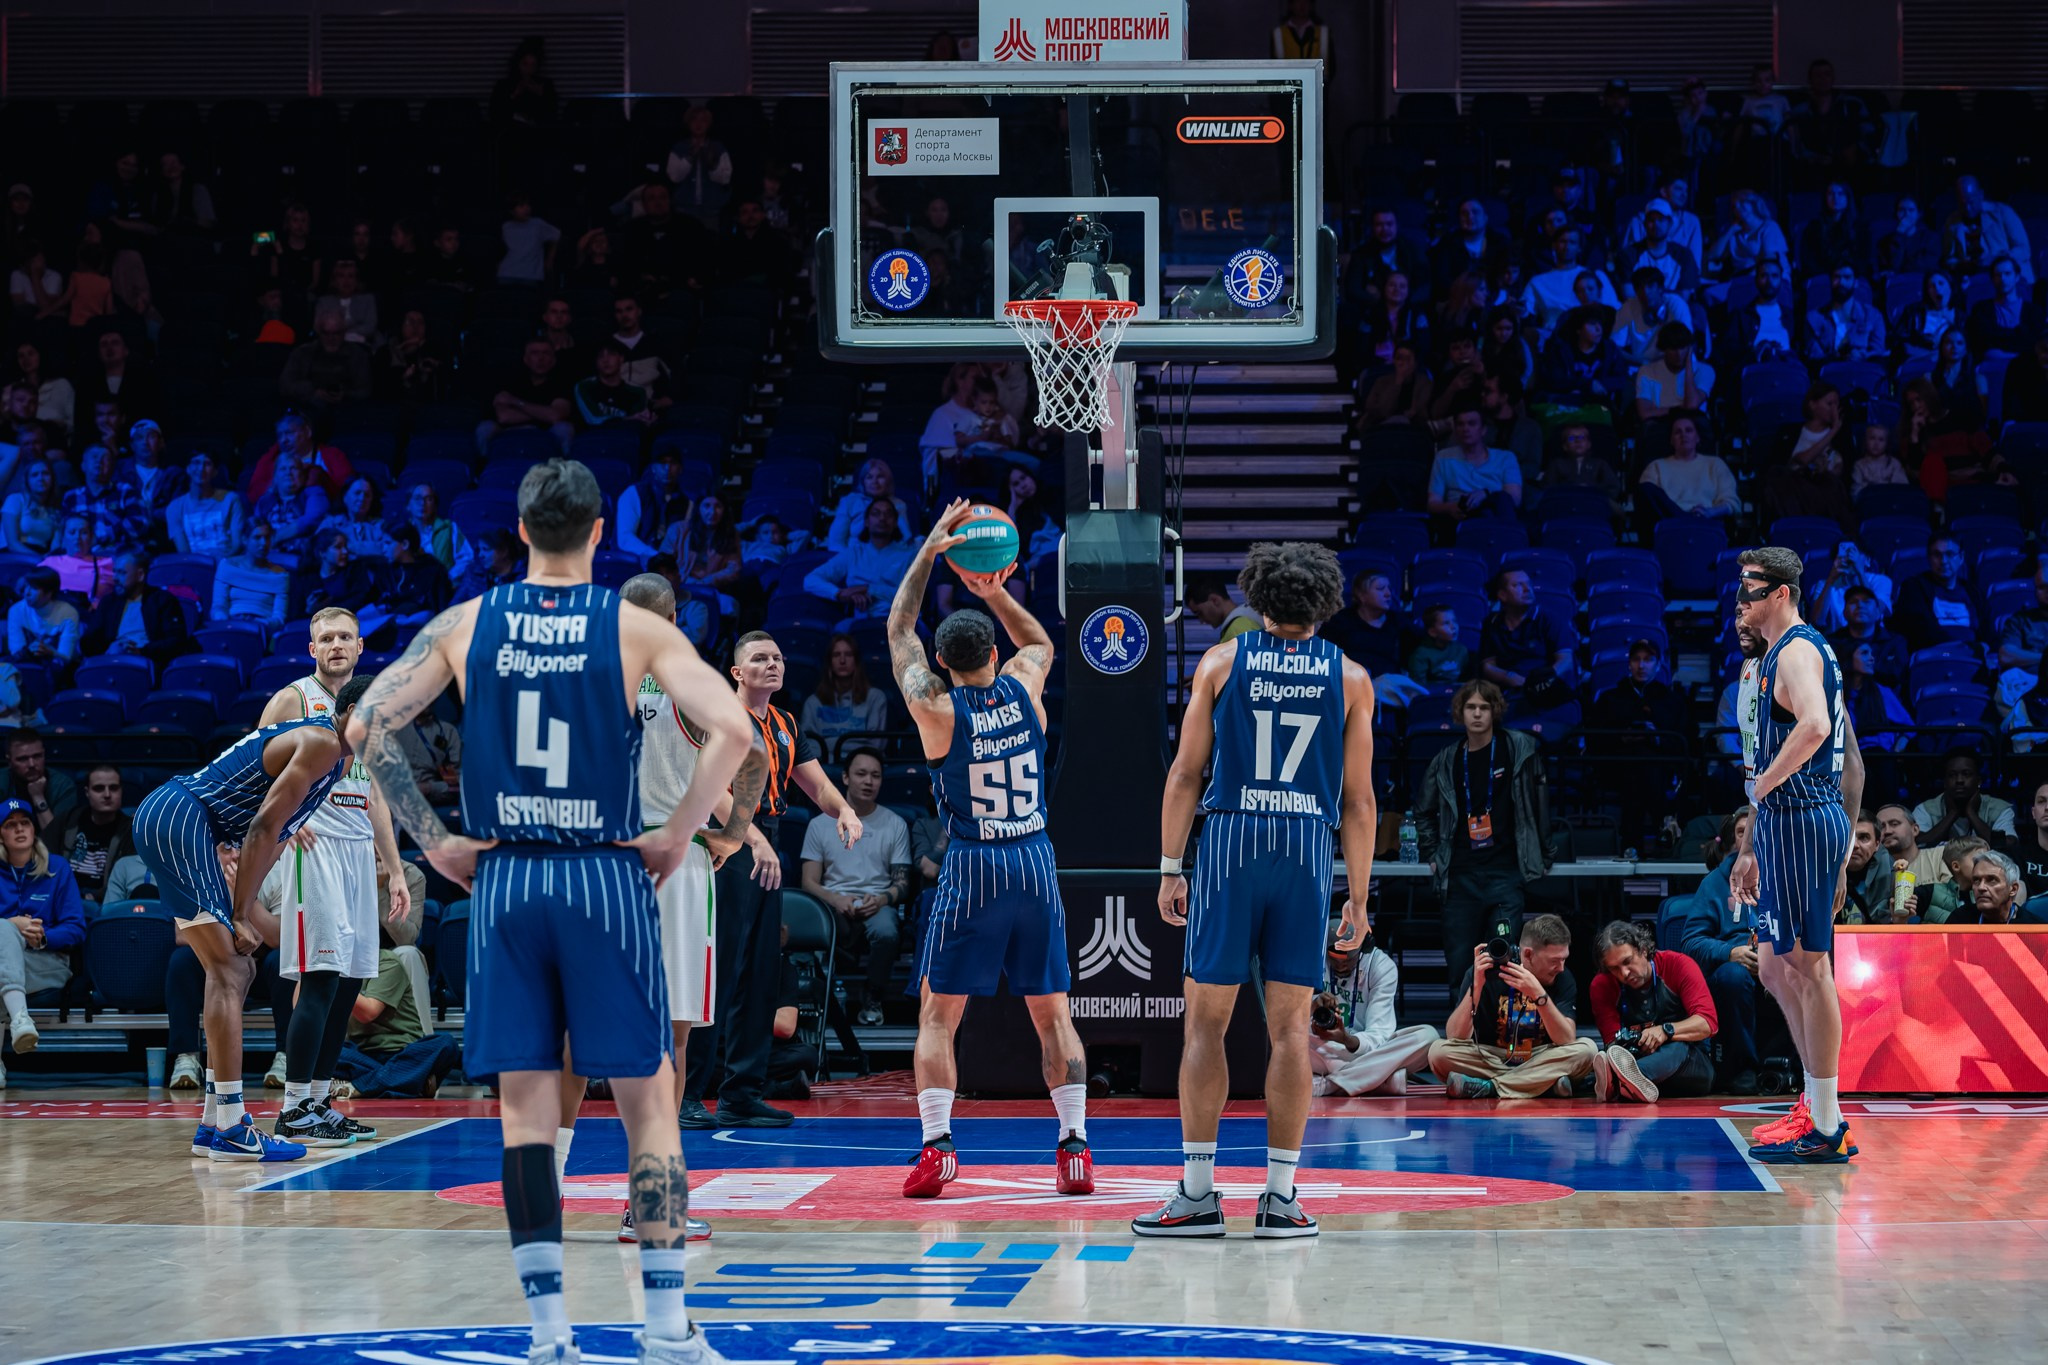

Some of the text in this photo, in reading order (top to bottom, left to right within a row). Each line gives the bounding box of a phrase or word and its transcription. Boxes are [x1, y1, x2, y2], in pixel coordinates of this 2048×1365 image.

[1045, 12, 1170, 40] МОСКОВСКИЙ
[1045, 43, 1104, 61] СПОРТ
[914, 128, 983, 139] Департамент
[1185, 122, 1261, 138] WINLINE
[914, 141, 950, 151] спорта
[915, 152, 993, 163] города Москвы
[1227, 248, 1280, 268] ЕДИНАЯ ЛИГА ВТБ
[1224, 274, 1233, 296] СЕЗОН
[1231, 292, 1256, 308] ПАМЯТИ
[504, 611, 588, 645] YUSTA
[1084, 609, 1108, 637] СУПЕРКУБОК
[1107, 608, 1130, 617] ЕДИНОЙ
[1128, 613, 1141, 626] ЛИГИ
[496, 643, 588, 679] Bilyoner
[1086, 651, 1100, 667] КУБОК
[1246, 651, 1330, 677] MALCOLM
[1249, 676, 1325, 703] Bilyoner
[969, 701, 1024, 738] JAMES
[516, 690, 570, 788] 4
[972, 729, 1031, 760] Bilyoner
[1252, 709, 1322, 783] 17
[968, 749, 1039, 819] 55
[333, 795, 367, 808] WINLINE
[496, 792, 604, 829] İSTANBUL
[1240, 785, 1323, 815] İSTANBUL
[1068, 993, 1186, 1018] КОВСКИЙ СПОР
[684, 1264, 1044, 1309] ВТБ
